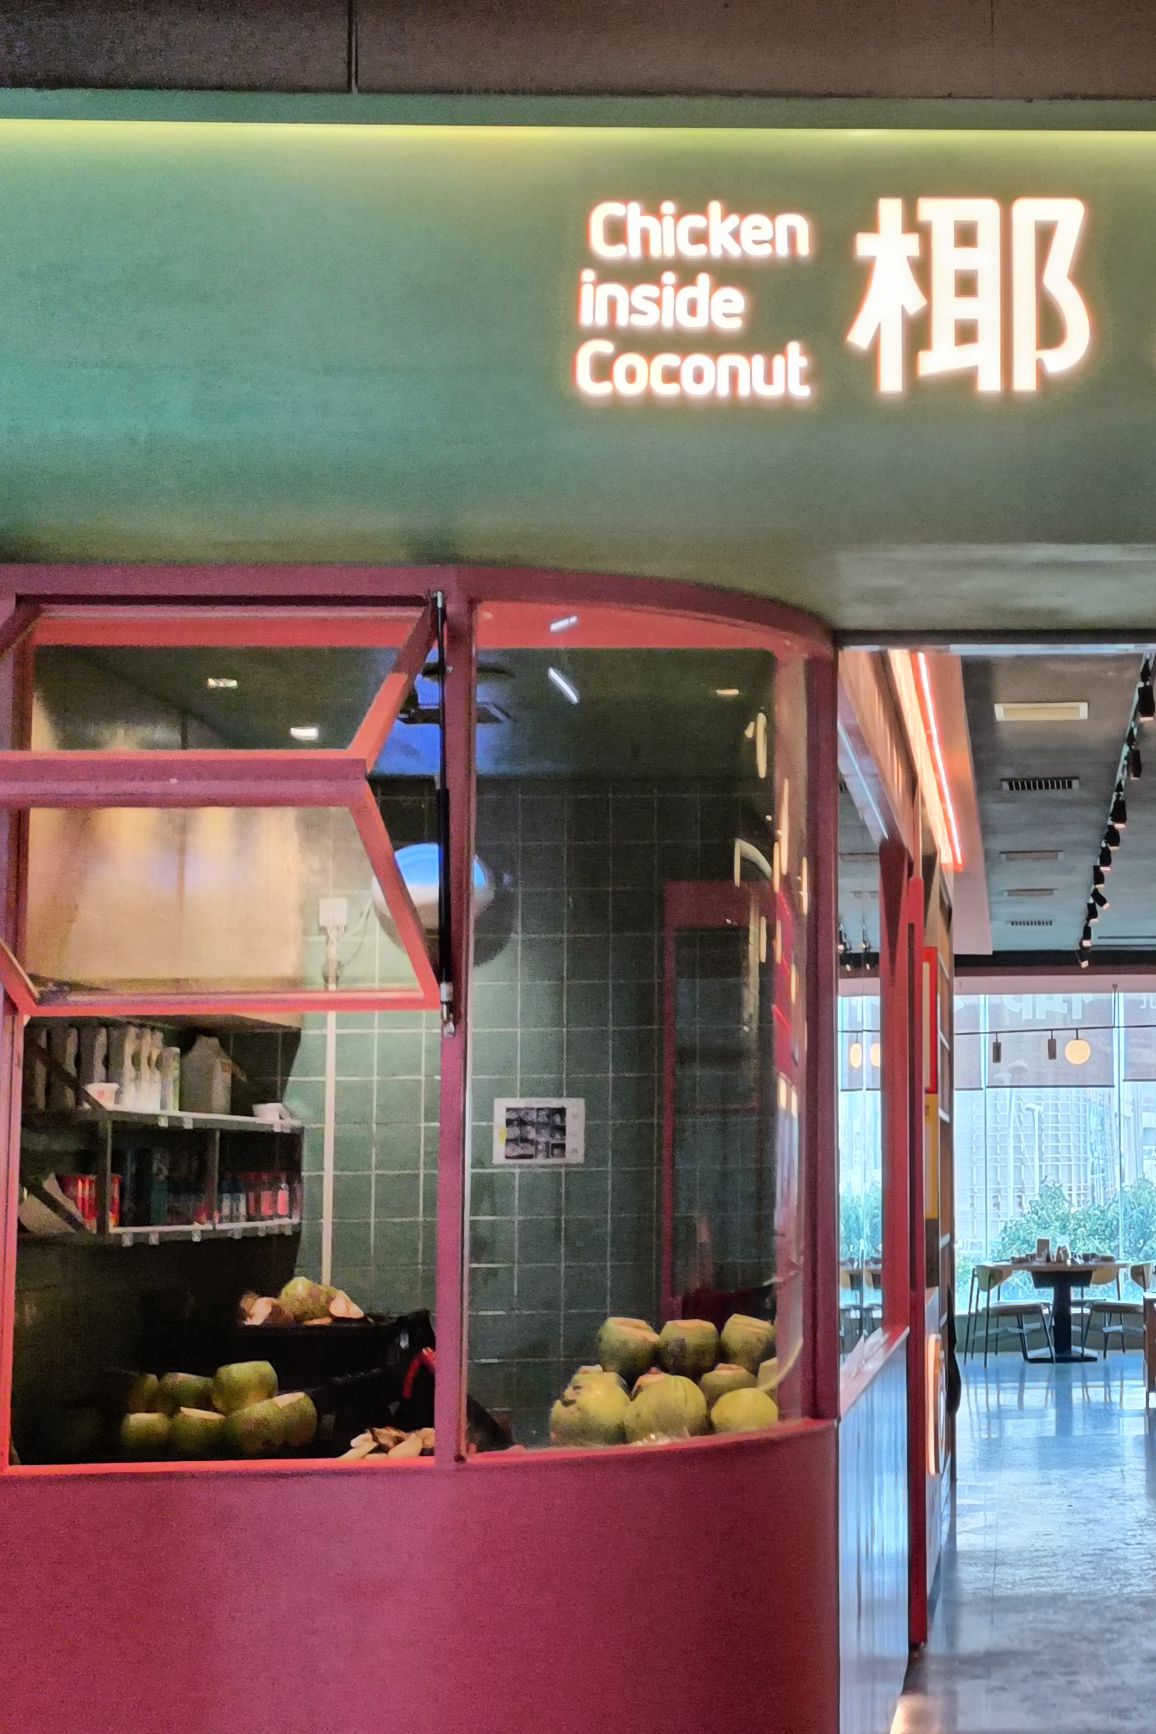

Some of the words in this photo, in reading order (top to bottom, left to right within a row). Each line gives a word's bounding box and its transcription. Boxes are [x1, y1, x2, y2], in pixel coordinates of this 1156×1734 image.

[589, 200, 810, 258] Chicken
[579, 269, 745, 329] inside
[575, 339, 811, 398] Coconut
